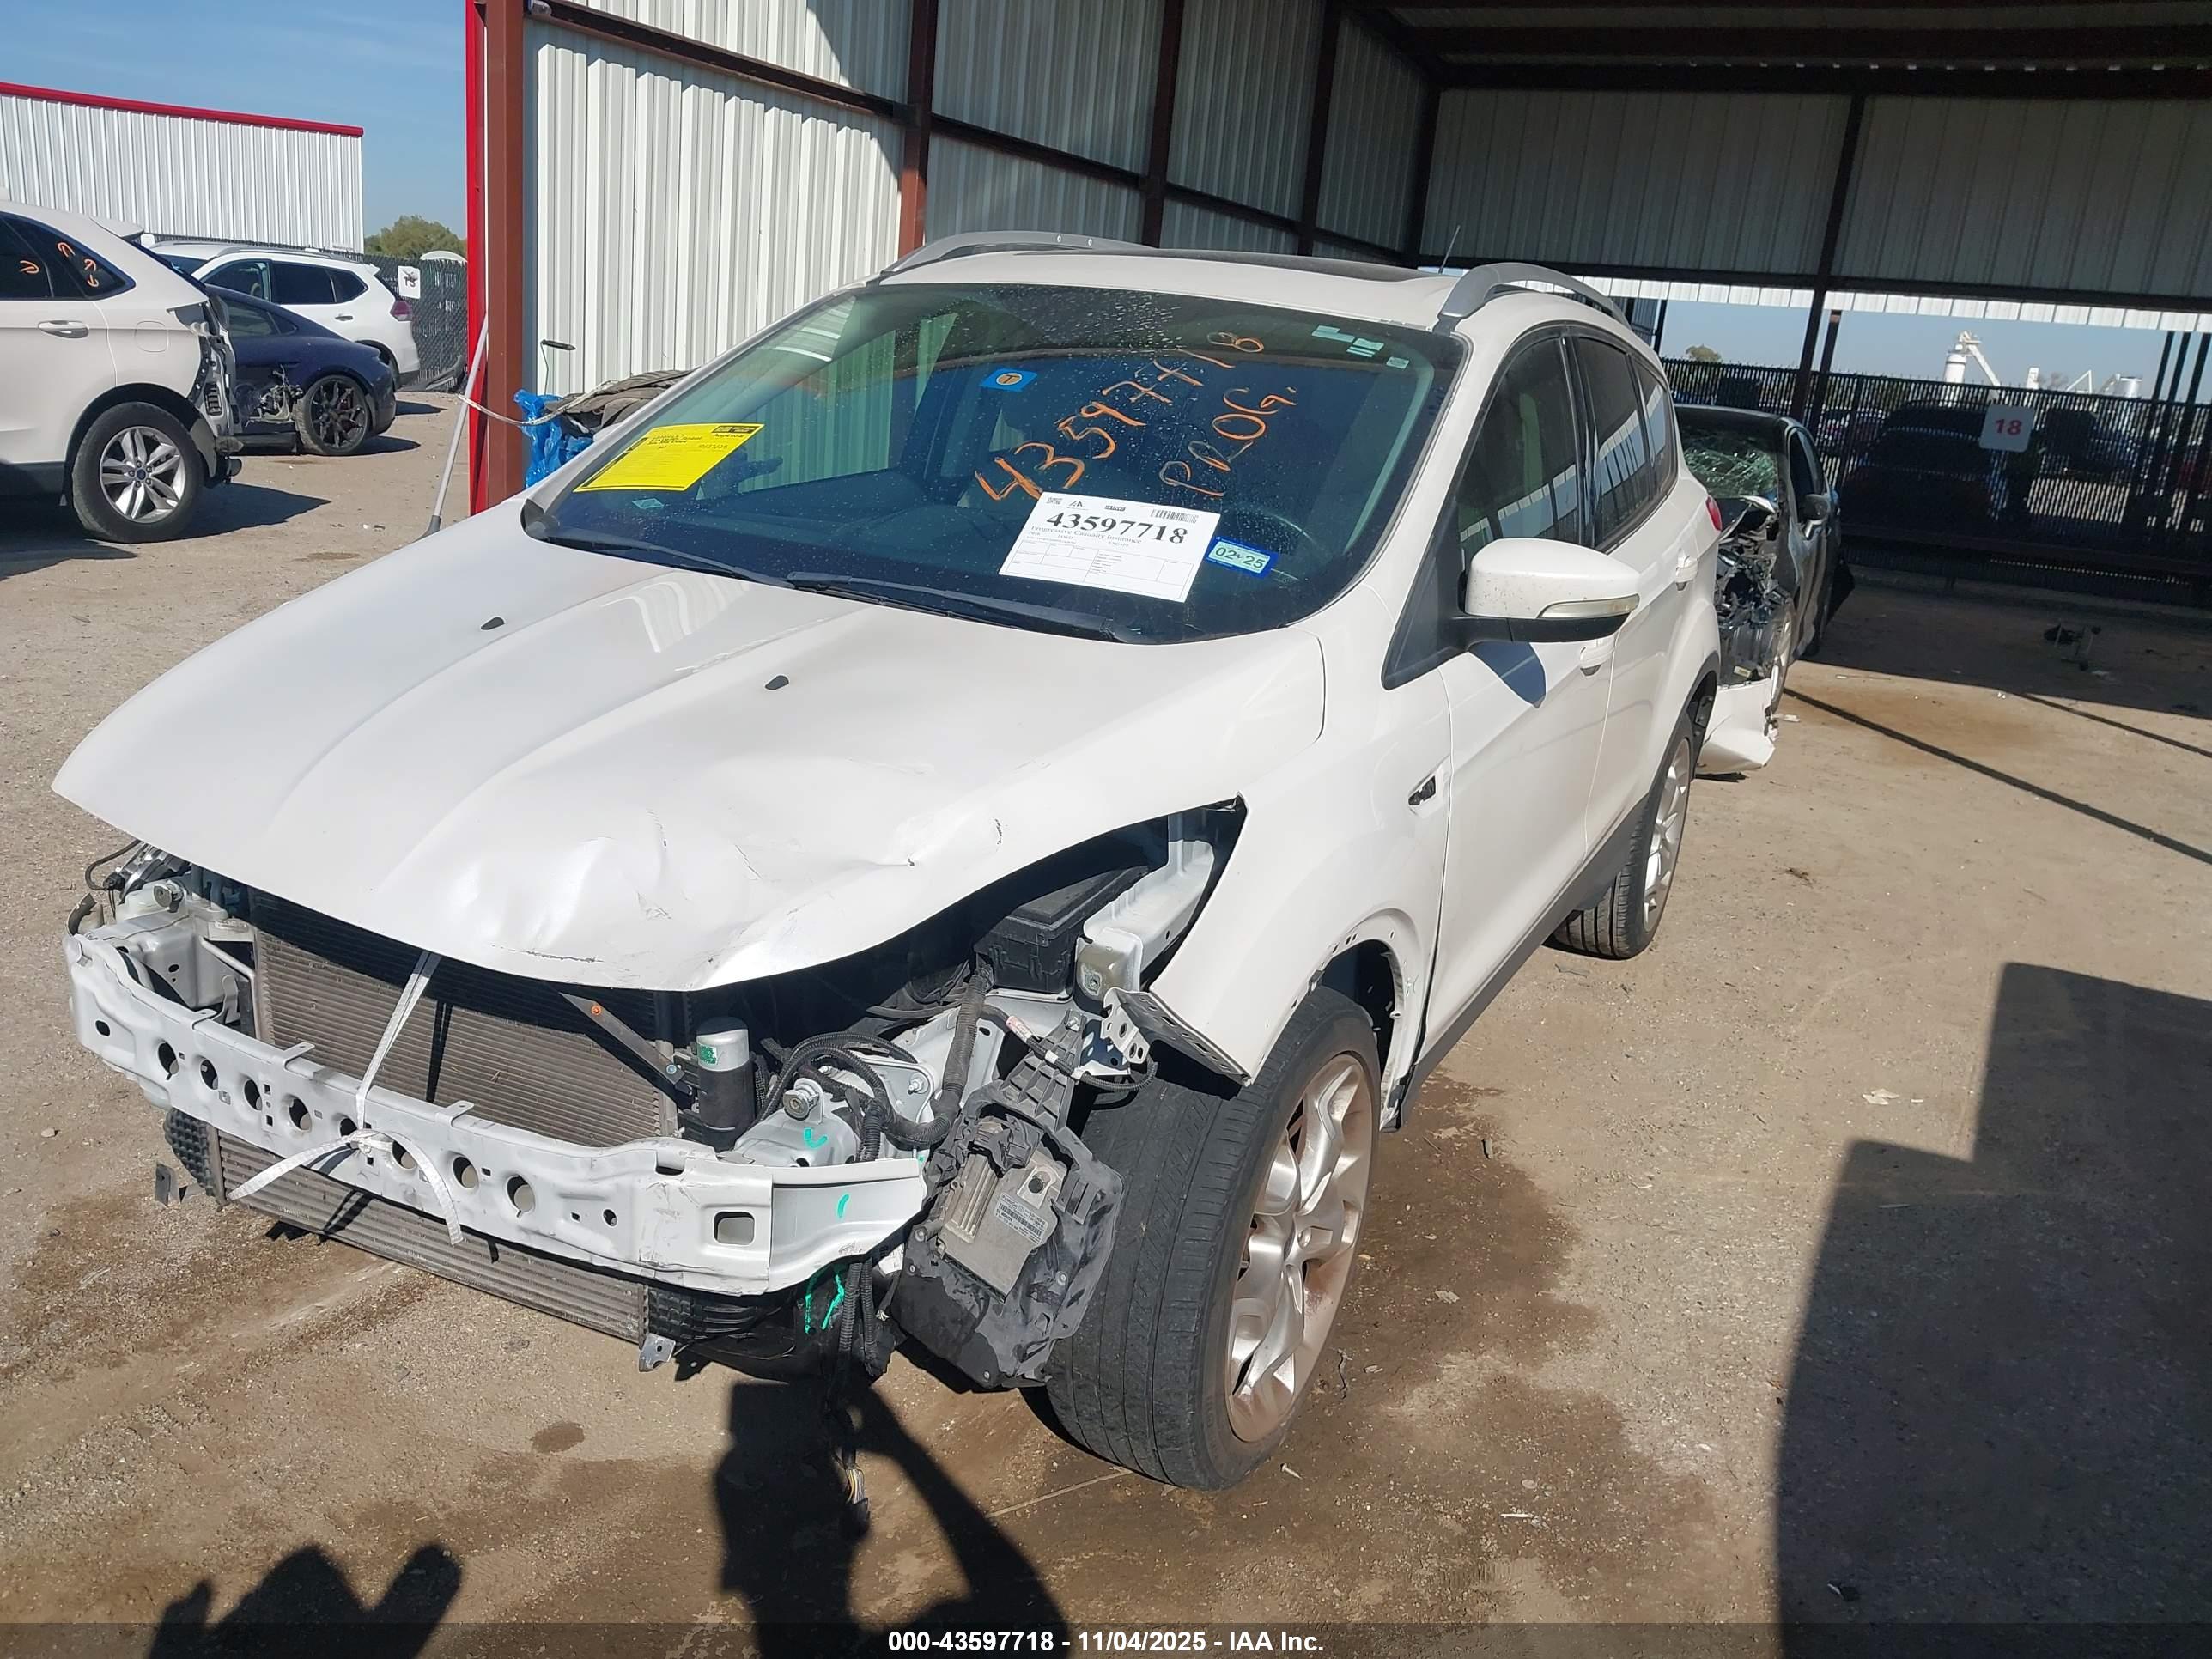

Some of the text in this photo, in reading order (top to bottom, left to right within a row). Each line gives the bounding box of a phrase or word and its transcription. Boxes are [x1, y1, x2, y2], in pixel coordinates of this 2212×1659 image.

[1996, 418, 2022, 435] 18
[1030, 525, 1143, 544] Progressive Casualty Insurance
[1046, 512, 1188, 544] 43597718
[1215, 547, 1237, 560] 02
[1242, 556, 1266, 568] 25
